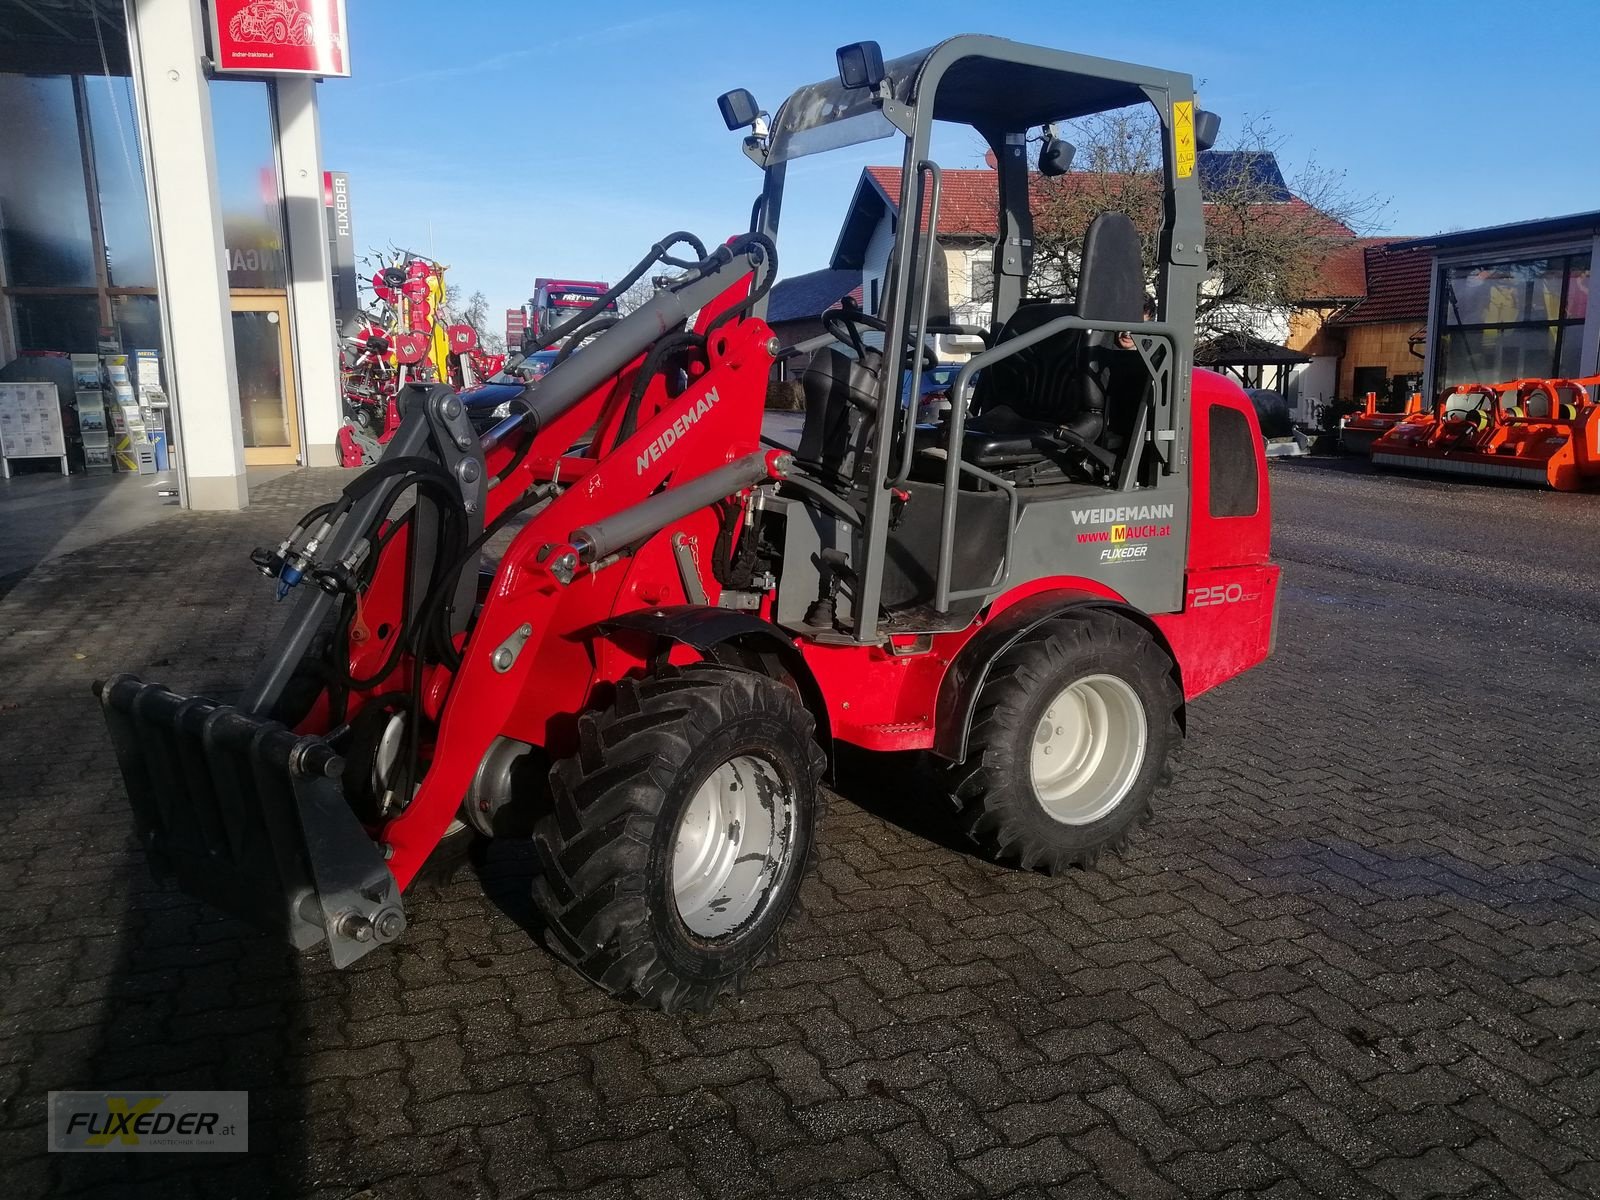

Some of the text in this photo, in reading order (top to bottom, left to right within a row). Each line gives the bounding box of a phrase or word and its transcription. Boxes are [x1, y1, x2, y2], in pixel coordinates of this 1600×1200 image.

[335, 178, 350, 237] FLIXEDER
[1071, 503, 1175, 526] WEIDEMANN
[1077, 524, 1171, 544] www.MAUCH.at
[1100, 546, 1148, 561] FLIXEDER
